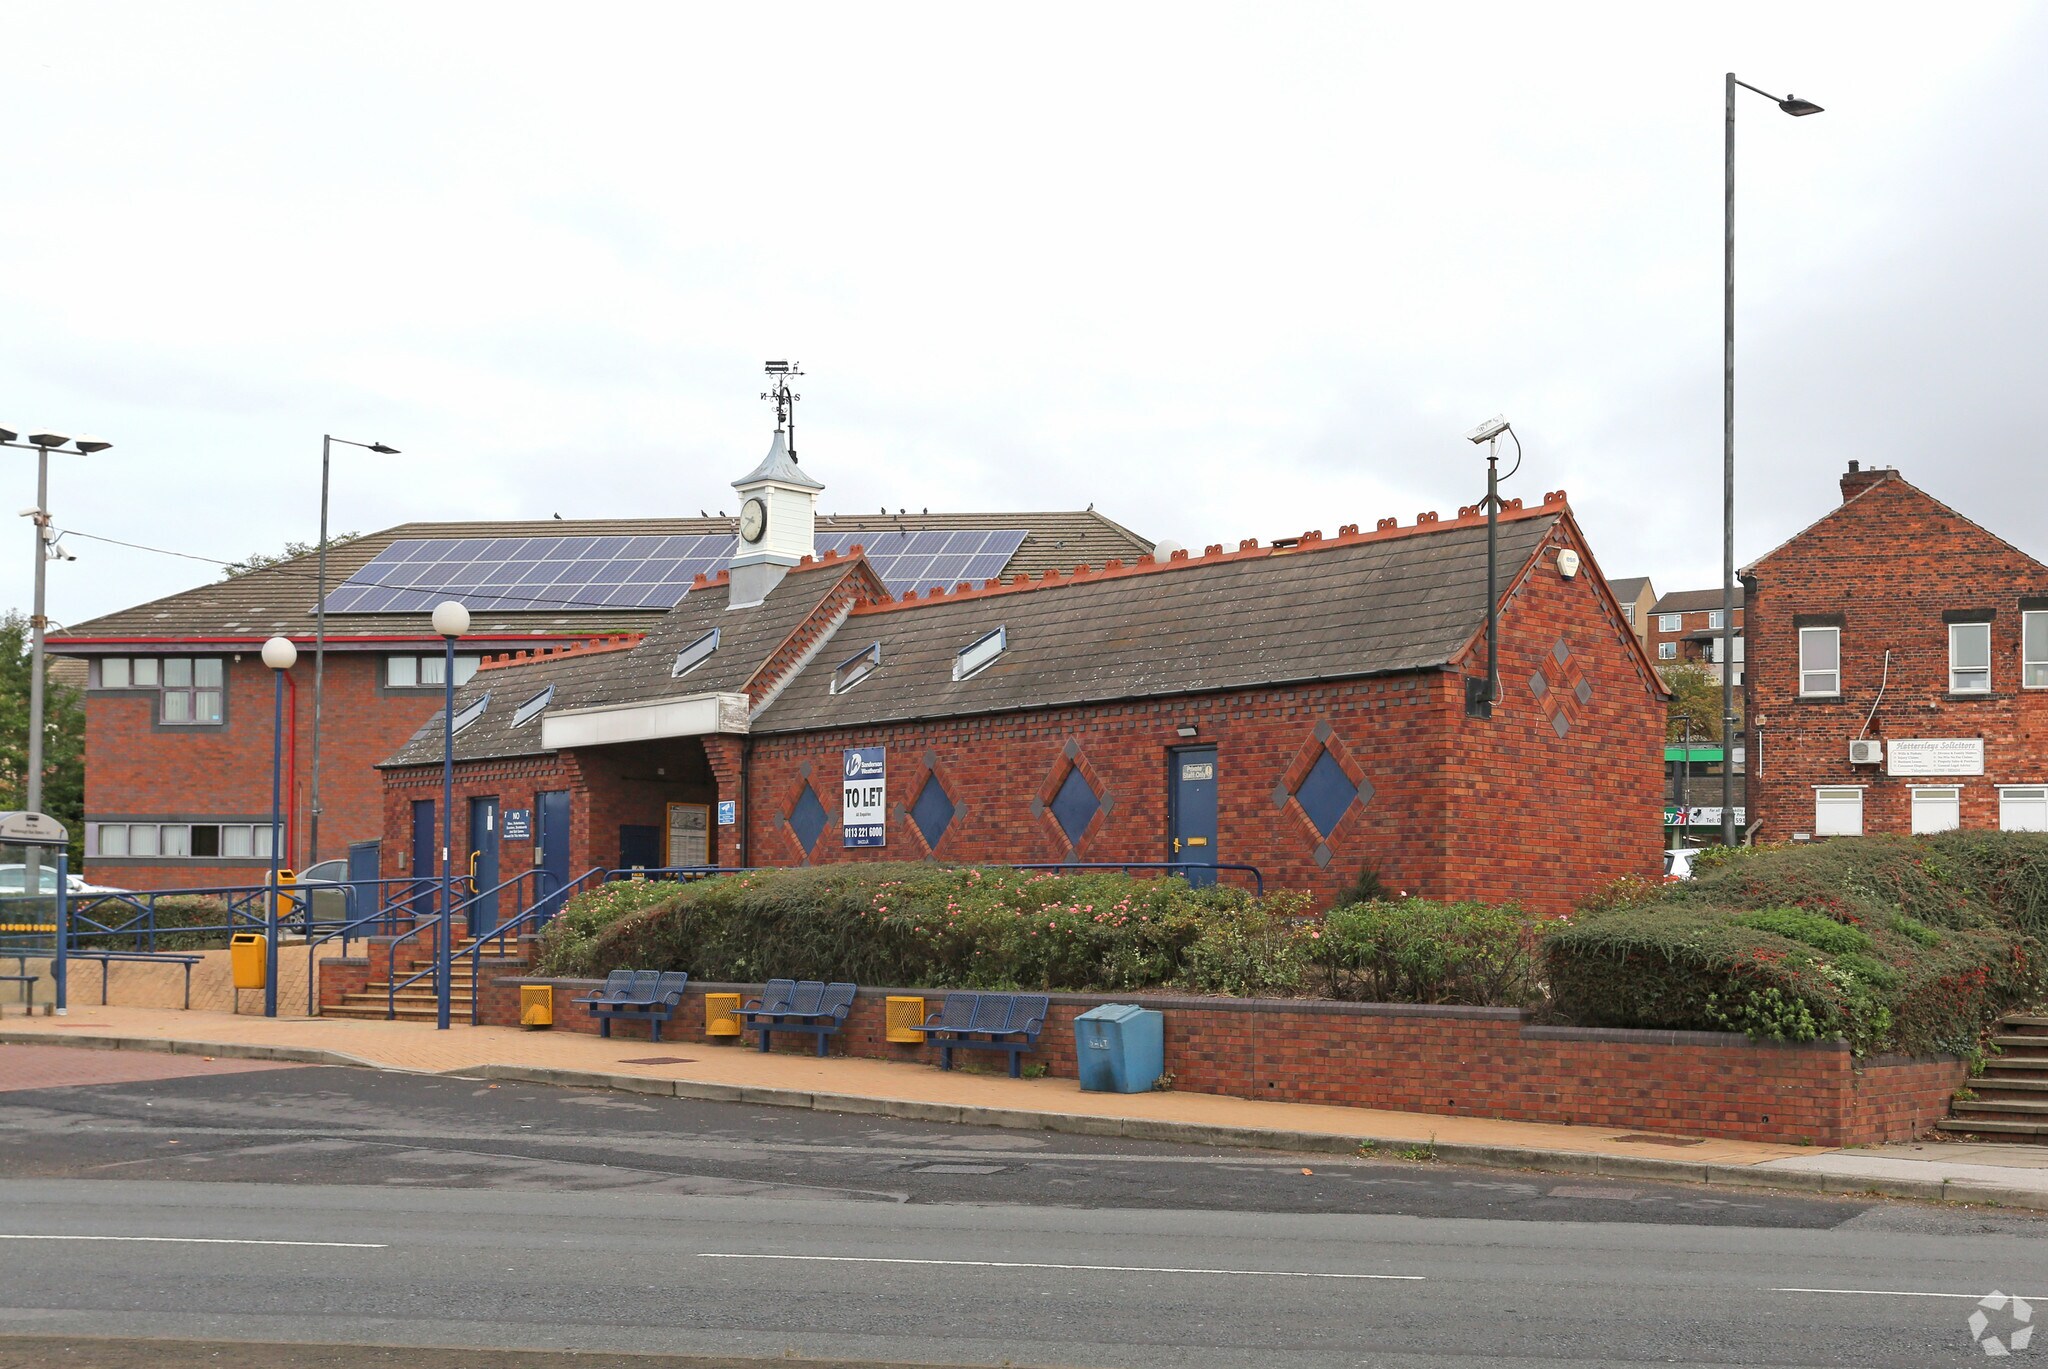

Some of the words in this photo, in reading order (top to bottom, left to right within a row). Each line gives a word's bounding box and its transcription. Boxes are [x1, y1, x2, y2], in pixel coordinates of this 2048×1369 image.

[1896, 742, 1938, 751] Hattersleys
[845, 788, 859, 808] TO
[863, 787, 882, 807] LET
[512, 812, 520, 820] NO
[845, 827, 858, 838] 0113
[859, 827, 868, 837] 221
[1089, 1040, 1108, 1048] SALT
